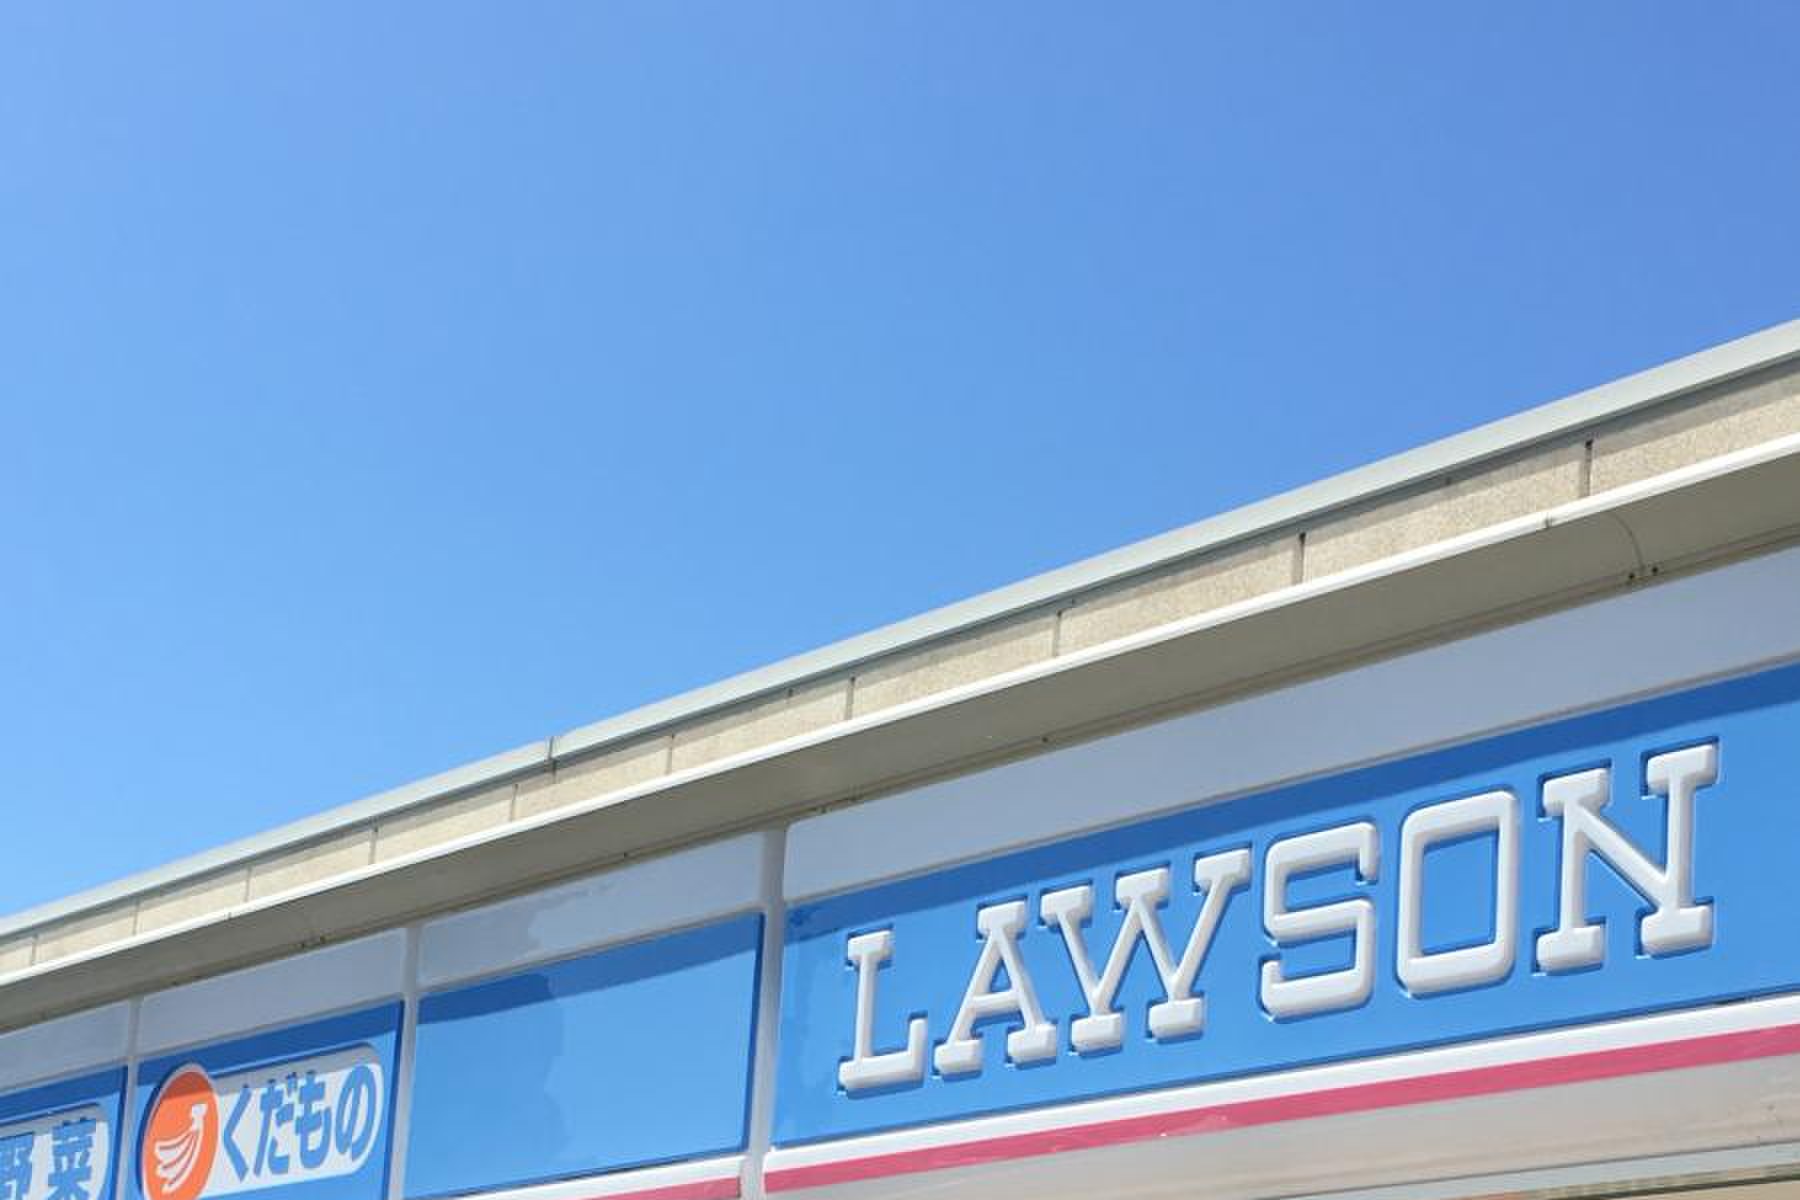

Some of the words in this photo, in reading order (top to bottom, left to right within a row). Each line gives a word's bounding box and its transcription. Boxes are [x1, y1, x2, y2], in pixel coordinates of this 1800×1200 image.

[838, 741, 1717, 1094] LAWSON
[223, 1065, 377, 1183] くだもの
